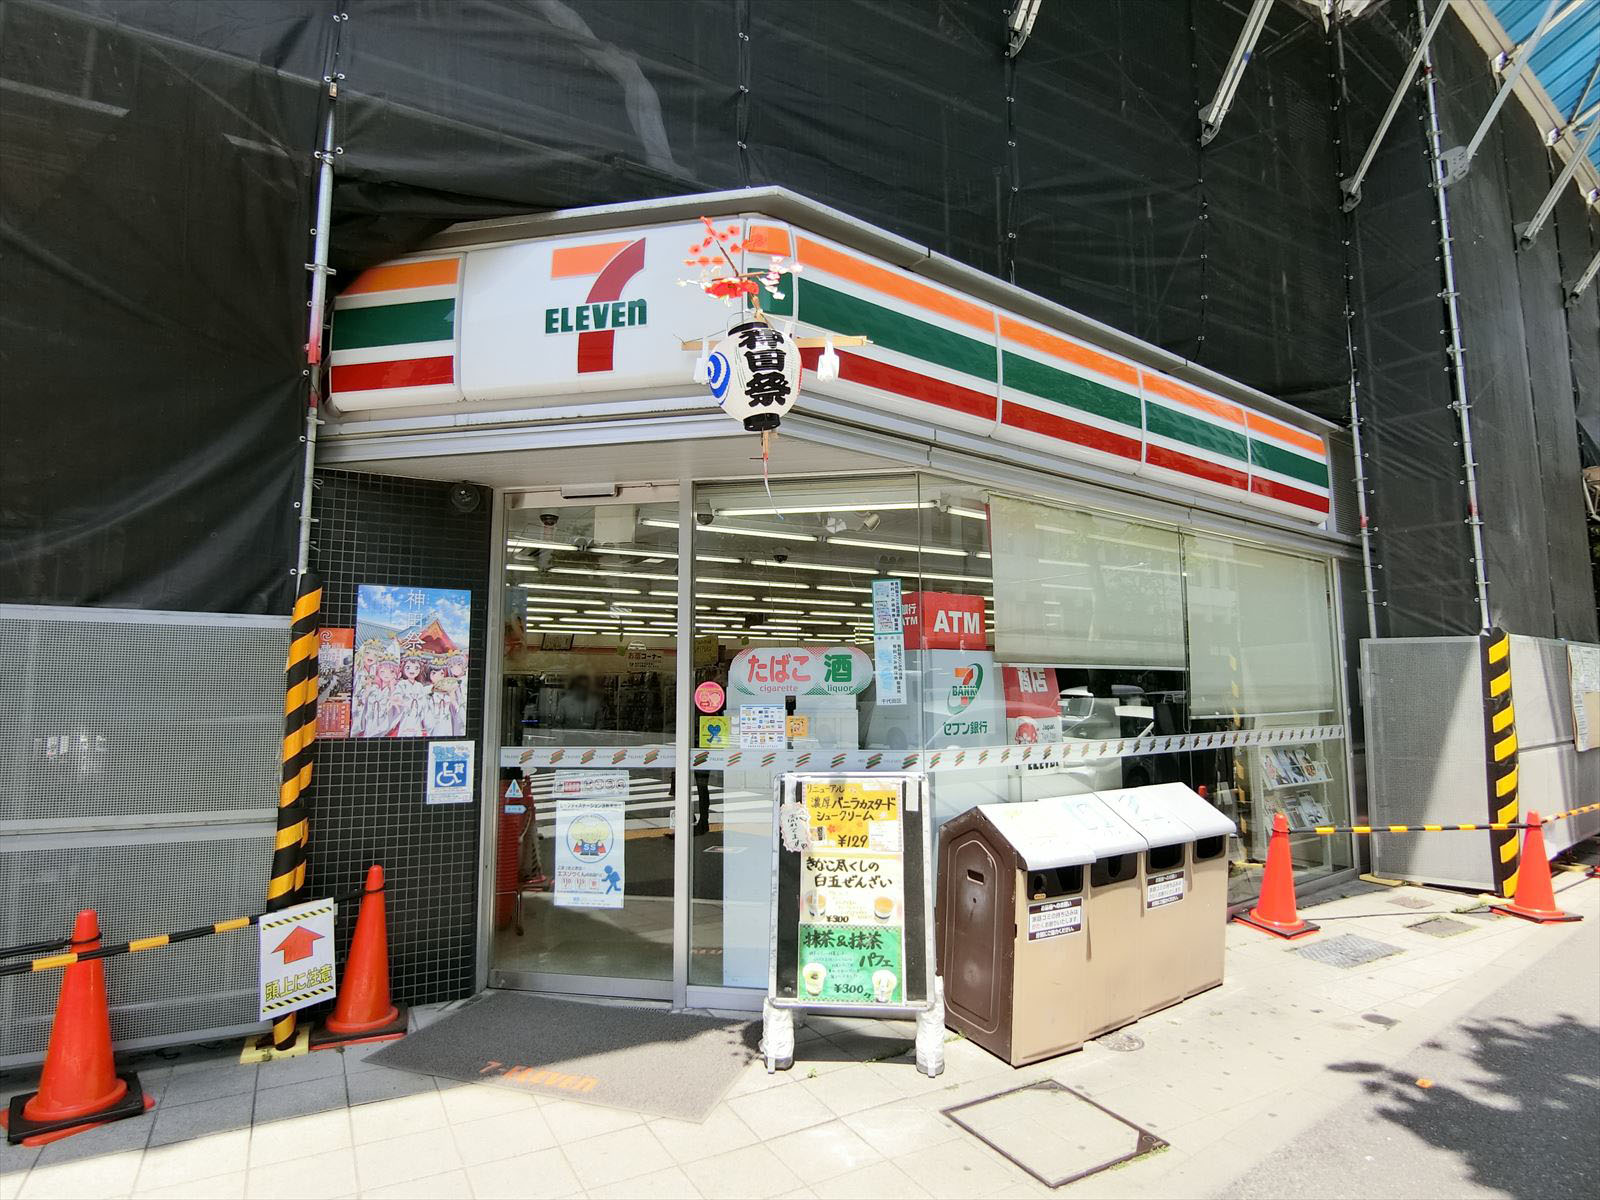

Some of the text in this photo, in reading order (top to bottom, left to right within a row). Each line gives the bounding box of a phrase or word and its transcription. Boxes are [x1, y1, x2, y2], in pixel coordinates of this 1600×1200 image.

[738, 328, 791, 408] 神田祭
[401, 589, 426, 650] 神田祭
[933, 609, 981, 635] ATM
[747, 653, 853, 683] たばこ 酒
[759, 684, 853, 694] cigarette liquor
[951, 685, 978, 697] BANK
[943, 721, 988, 736] セブン銀行
[807, 784, 845, 794] リニューアル
[816, 810, 875, 822] シュークリーム
[838, 834, 869, 848] ¥129
[826, 915, 849, 923] ¥300
[858, 952, 894, 968] パフェ
[265, 963, 333, 1002] 頭上に注意
[834, 983, 864, 994] ¥300
